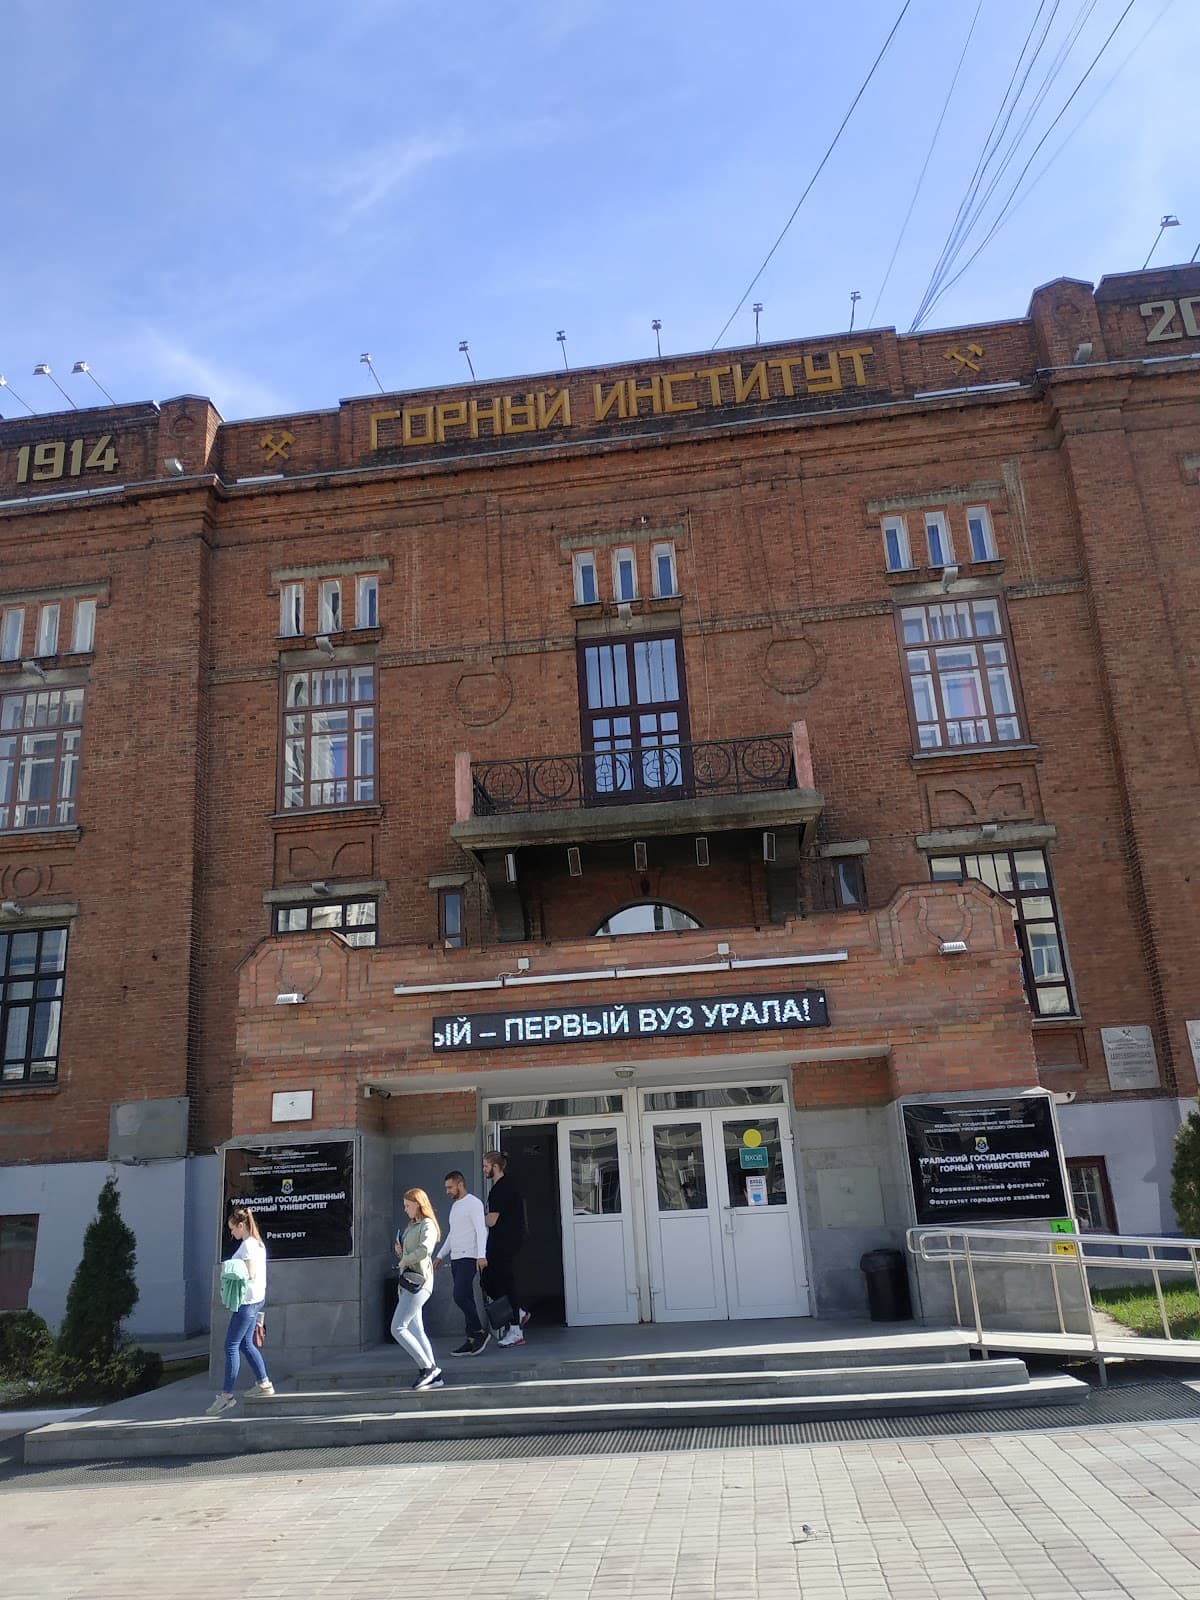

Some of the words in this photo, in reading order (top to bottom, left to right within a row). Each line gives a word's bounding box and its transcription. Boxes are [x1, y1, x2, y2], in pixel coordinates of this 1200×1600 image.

[369, 384, 571, 450] ГОРНЫЙ
[594, 347, 874, 422] ИНСТИТУТ
[16, 435, 119, 483] 1914
[505, 1006, 630, 1042] ПЕРВЫЙ
[638, 1006, 694, 1032] ВУЗ
[701, 999, 811, 1028] УРАЛА!
[919, 1154, 968, 1165] УРАЛЬСКИЙ
[970, 1150, 1050, 1162] ГОСУДАРСТВЕННЫЙ
[940, 1163, 974, 1173] ГОРНЫЙ
[976, 1161, 1031, 1171] УНИВЕРСИТЕТ
[231, 1195, 274, 1206] УРАЛЬСКИЙ
[275, 1191, 346, 1204] ГОСУДАРСТВЕННЫЙ
[279, 1201, 328, 1212] УНИВЕРСИТЕТ
[266, 1231, 307, 1240] Ректорат
